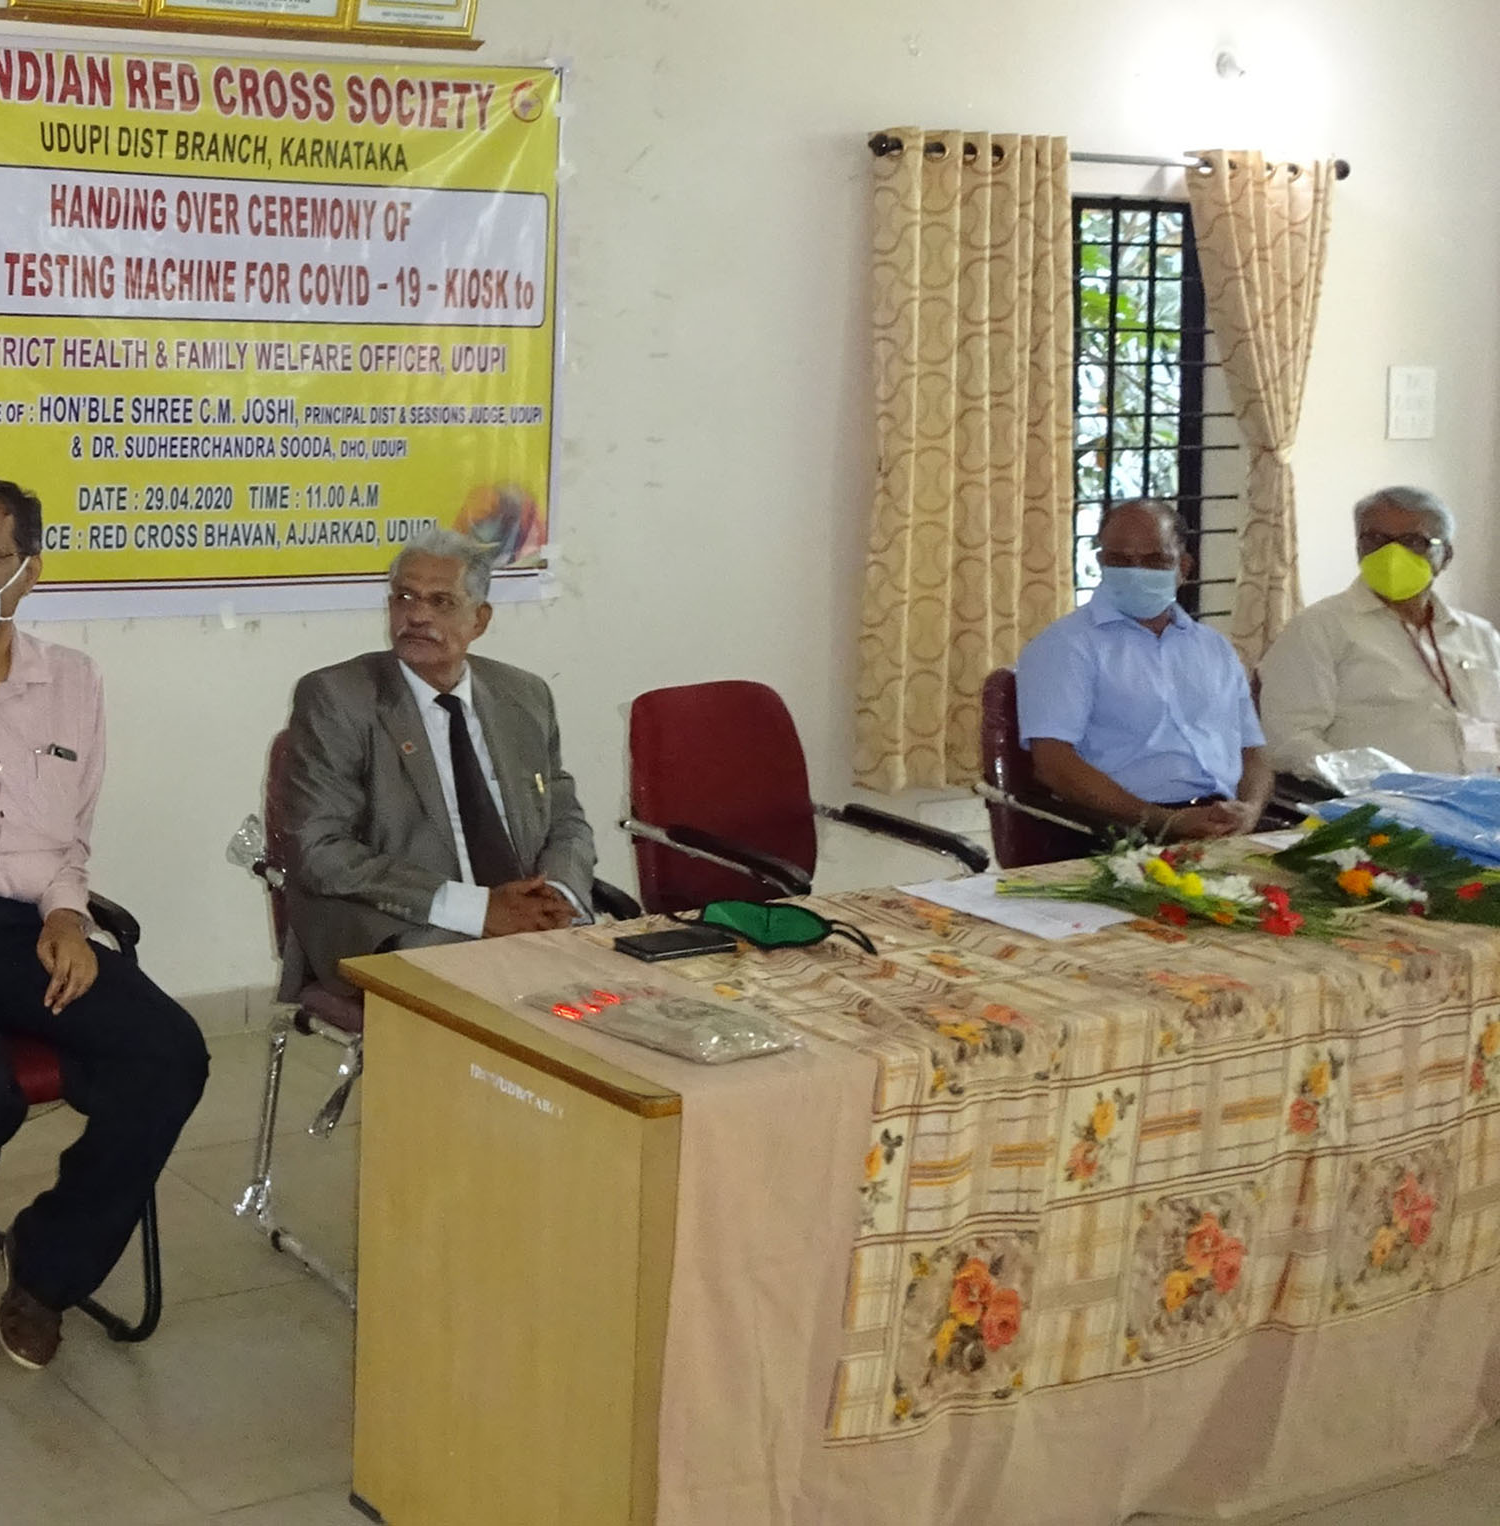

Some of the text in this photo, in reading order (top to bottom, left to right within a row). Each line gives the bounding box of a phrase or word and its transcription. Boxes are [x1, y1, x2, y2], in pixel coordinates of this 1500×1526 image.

[126, 59, 200, 112] RED
[213, 66, 334, 122] CROSS
[347, 75, 495, 130] SOCIETY
[40, 121, 408, 172] UDUPI DIST BRANCH, KARNATAKA
[50, 184, 412, 242] HANDING OVER CEREMONY OF
[5, 252, 115, 299] TESTING
[125, 257, 236, 303] MACHINE
[245, 261, 290, 304] FOR
[300, 263, 370, 306] COVID
[396, 266, 420, 308] 19
[444, 268, 509, 309] KIOSK
[514, 273, 535, 310] to
[63, 338, 148, 369] HEALTH
[155, 341, 169, 369] &
[176, 341, 248, 370] FAMILY
[255, 342, 352, 372] WELFARE
[359, 344, 445, 375] OFFICER,
[451, 346, 507, 373] UDUPI
[6, 403, 25, 422] OF
[131, 397, 193, 424] SHREE
[199, 398, 235, 424] C.M.
[242, 398, 298, 428] JOSHI,
[305, 406, 366, 424] PRINCIPAL
[370, 406, 396, 424] DIST
[399, 406, 406, 424] &
[409, 406, 465, 424] SESSIONS
[468, 406, 507, 426] JUDGE,
[511, 406, 542, 424] UDUPI
[71, 435, 407, 460] & DR. SUDHEERCHANDRA SOODA, DHO, UDUPI
[78, 486, 127, 511] DATE
[145, 486, 233, 511] 29.04.2020
[250, 485, 290, 509] TIME
[306, 484, 344, 509] 11.00
[349, 483, 379, 508] A.M
[89, 524, 127, 550] RED
[134, 523, 198, 549] CROSS
[204, 522, 281, 549] BHAVAN,
[286, 520, 380, 546] AJJARKAD,
